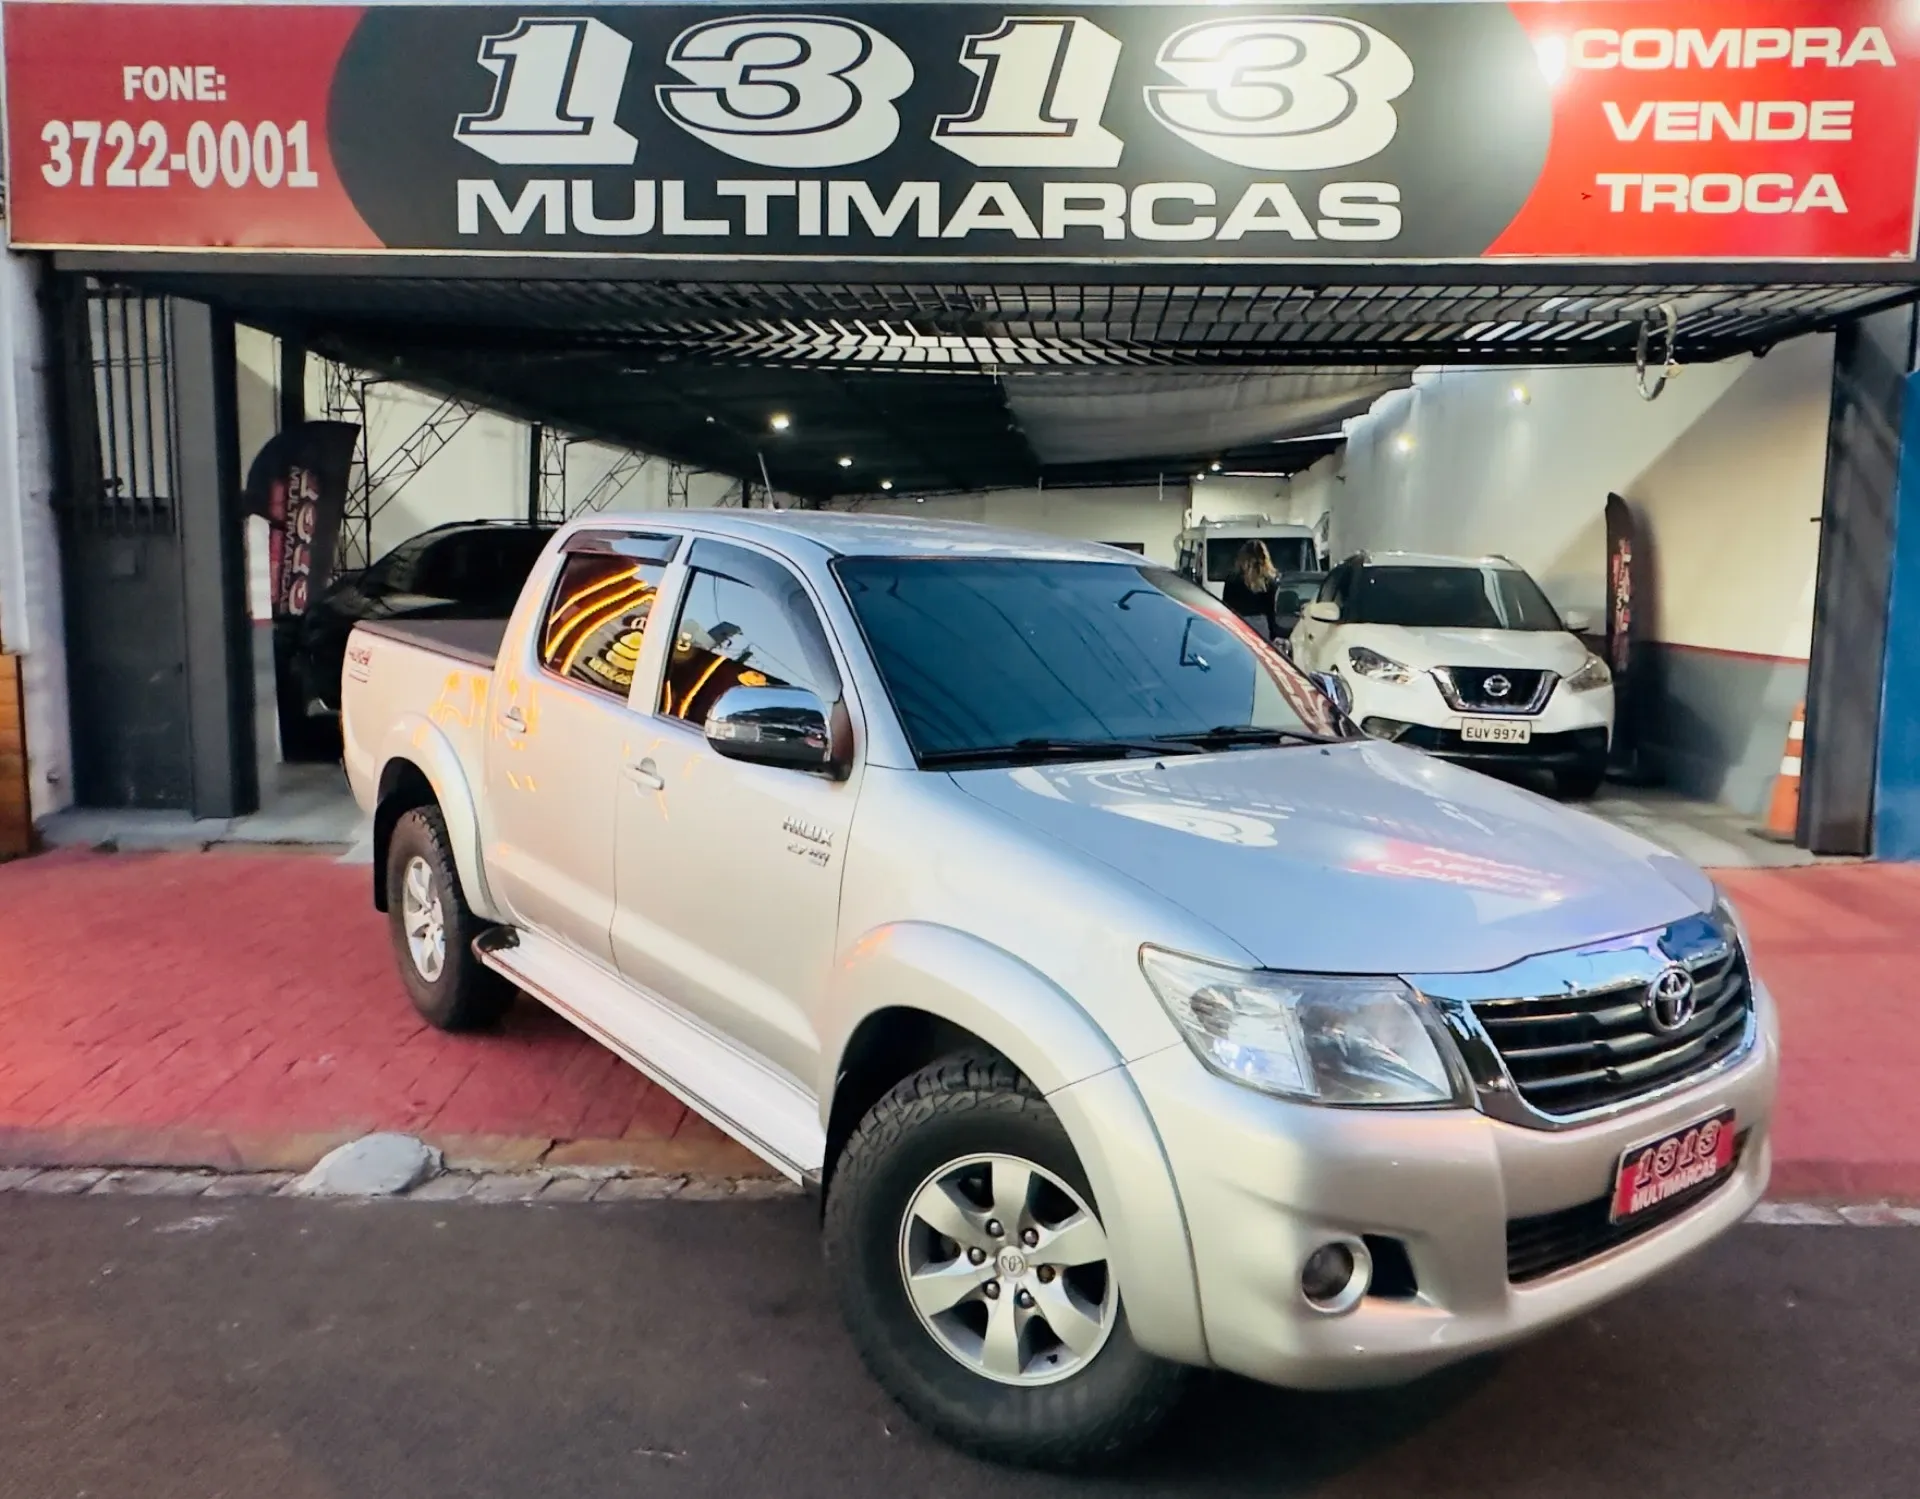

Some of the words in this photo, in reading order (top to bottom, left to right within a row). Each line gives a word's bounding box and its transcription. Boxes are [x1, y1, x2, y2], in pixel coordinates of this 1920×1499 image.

[1570, 26, 1897, 70] COMPRA
[123, 65, 227, 101] FONE:
[453, 14, 1415, 170] 1313
[1602, 100, 1855, 141] VENDE
[40, 119, 319, 188] 3722-0001
[457, 179, 1403, 241] MULTIMARCAS
[1595, 172, 1849, 214] TROCA
[1493, 728, 1526, 741] 9974
[1633, 1118, 1723, 1190] 1313
[1629, 1156, 1718, 1215] MULTIMARCAS
